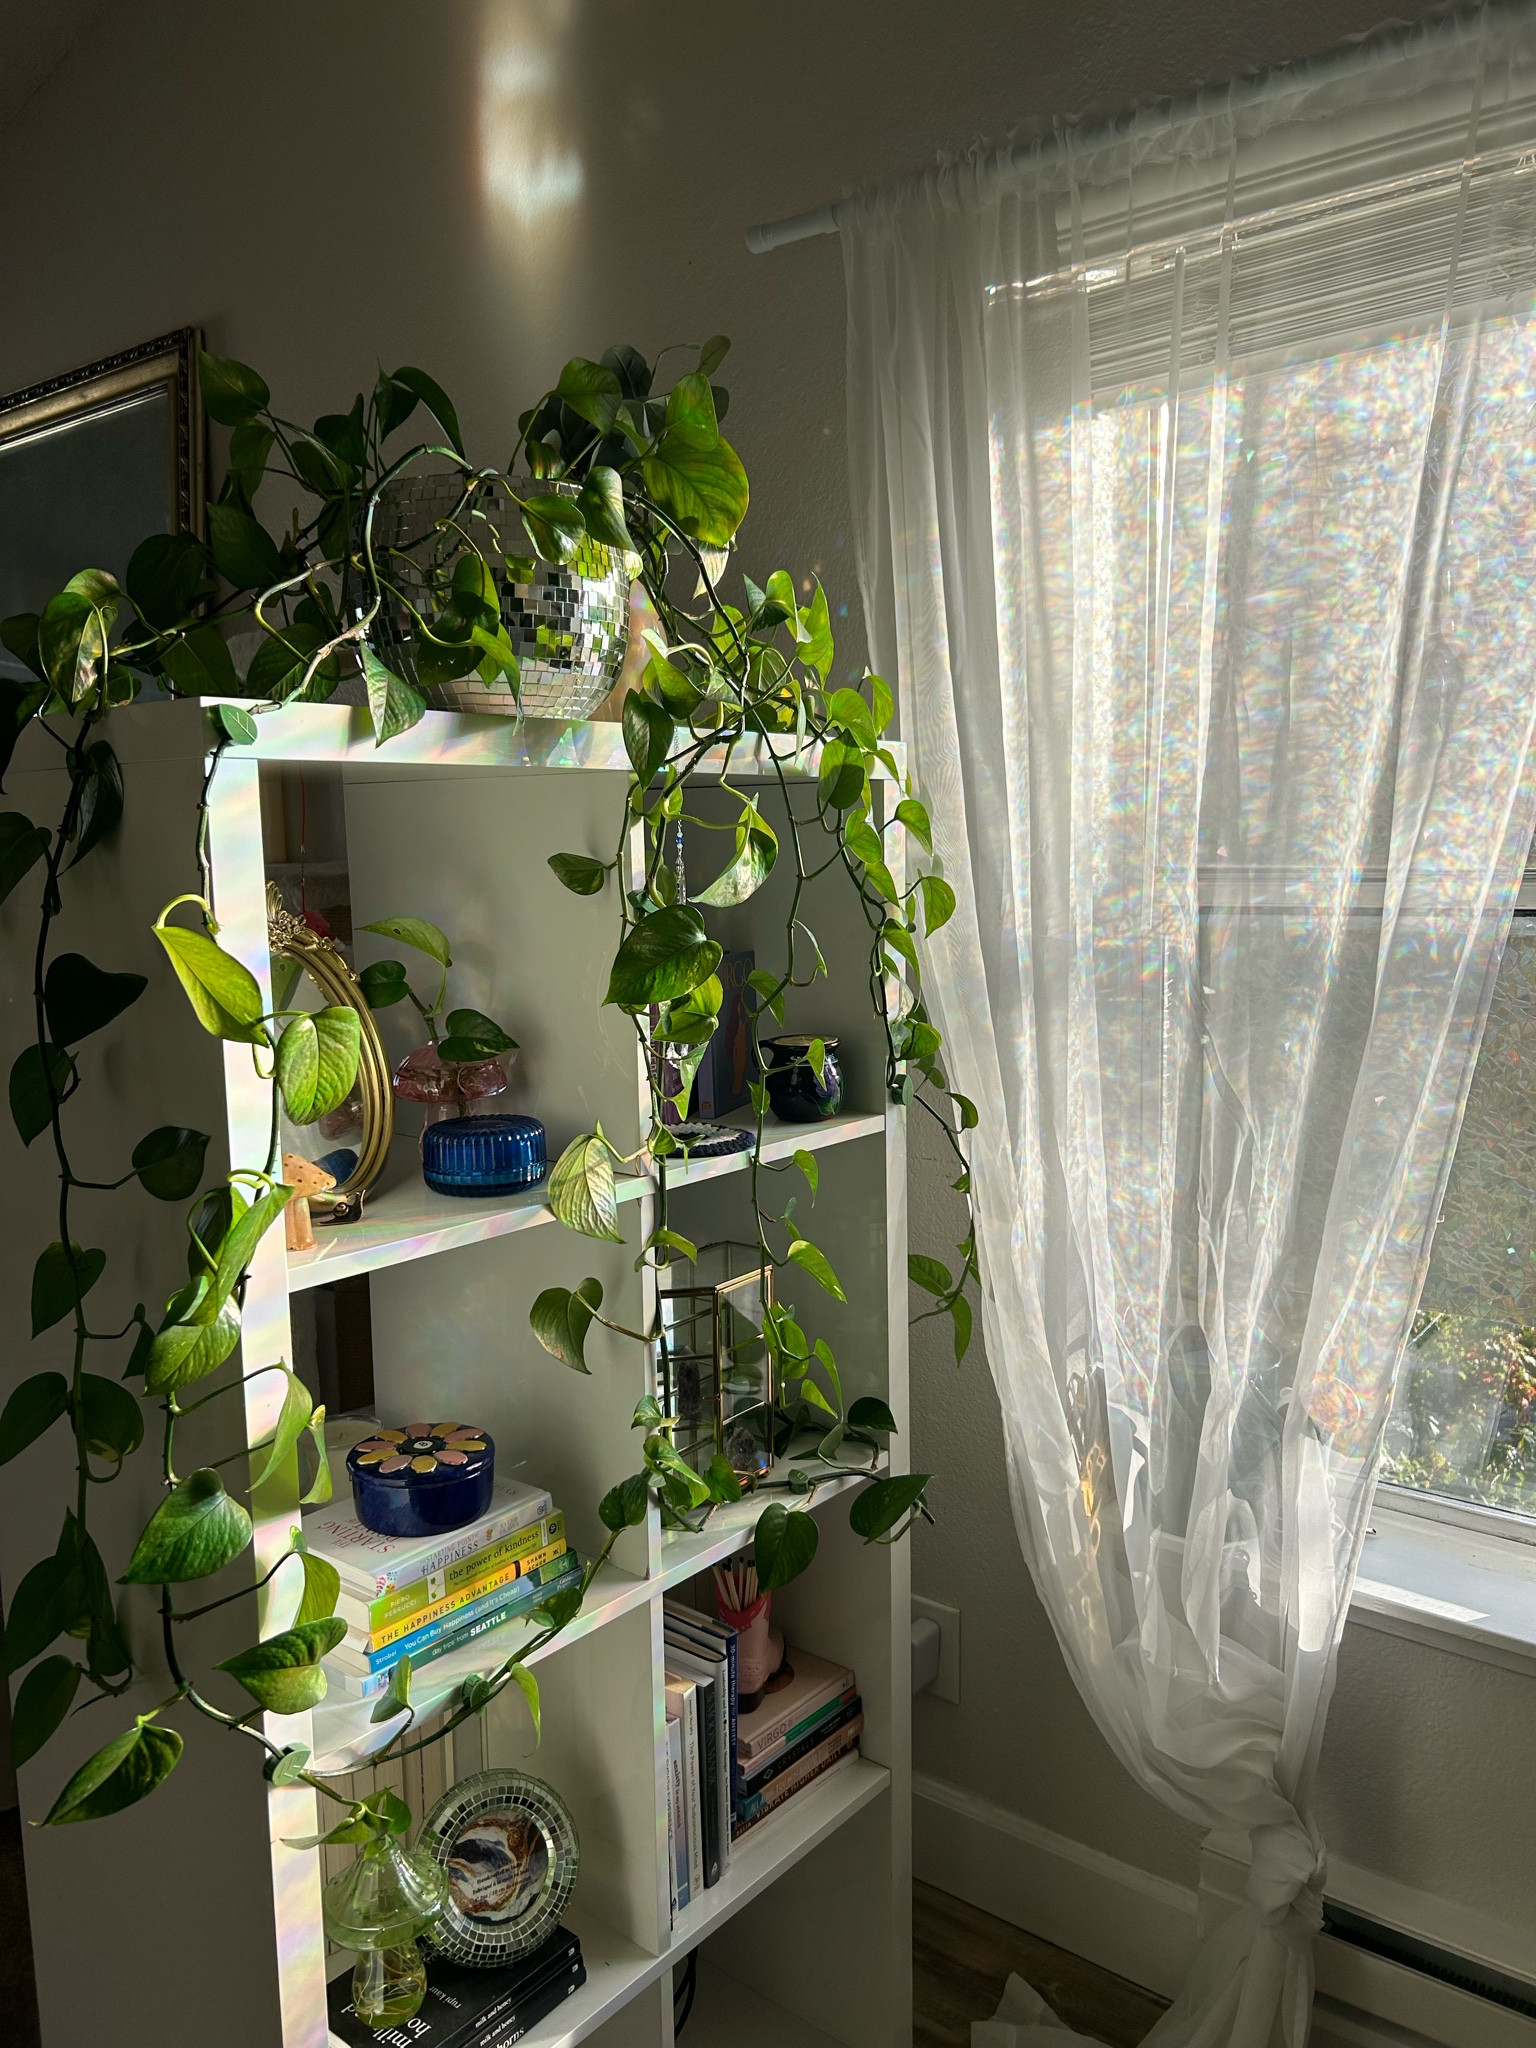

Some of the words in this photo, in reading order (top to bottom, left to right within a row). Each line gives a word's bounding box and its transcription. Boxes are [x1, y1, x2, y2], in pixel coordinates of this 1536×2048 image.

[722, 957, 753, 988] IRGO
[317, 1520, 395, 1553] STARTING
[420, 1541, 478, 1576] HAPPINESS
[449, 1564, 464, 1581] the
[465, 1555, 491, 1575] power
[493, 1545, 504, 1560] of
[504, 1532, 539, 1555] kindness
[527, 1552, 546, 1566] SHAWN
[381, 1629, 399, 1643] THE
[403, 1601, 456, 1633] HAPPINESS
[459, 1572, 510, 1604] ADVANTAGE
[384, 1600, 417, 1618] FERRUCCI
[390, 1595, 409, 1608] PIERO
[375, 1650, 397, 1665] Strobel
[404, 1640, 416, 1650] You
[416, 1634, 430, 1644] Can
[430, 1627, 441, 1639] Buy
[443, 1610, 474, 1629] Happiness
[499, 1585, 520, 1602] Cheap)
[432, 1645, 442, 1656] day
[456, 1631, 469, 1643] from
[470, 1610, 507, 1637] SEATTLE
[757, 1723, 786, 1750] VIRGO
[673, 1759, 681, 1787] anxiety
[428, 1986, 447, 2003] kaur
[445, 1995, 462, 2009] rupi
[487, 2007, 497, 2019] and
[497, 1997, 512, 2011] honey
[480, 2033, 491, 2047] milk
[492, 2025, 501, 2037] and
[501, 2014, 516, 2029] honey
